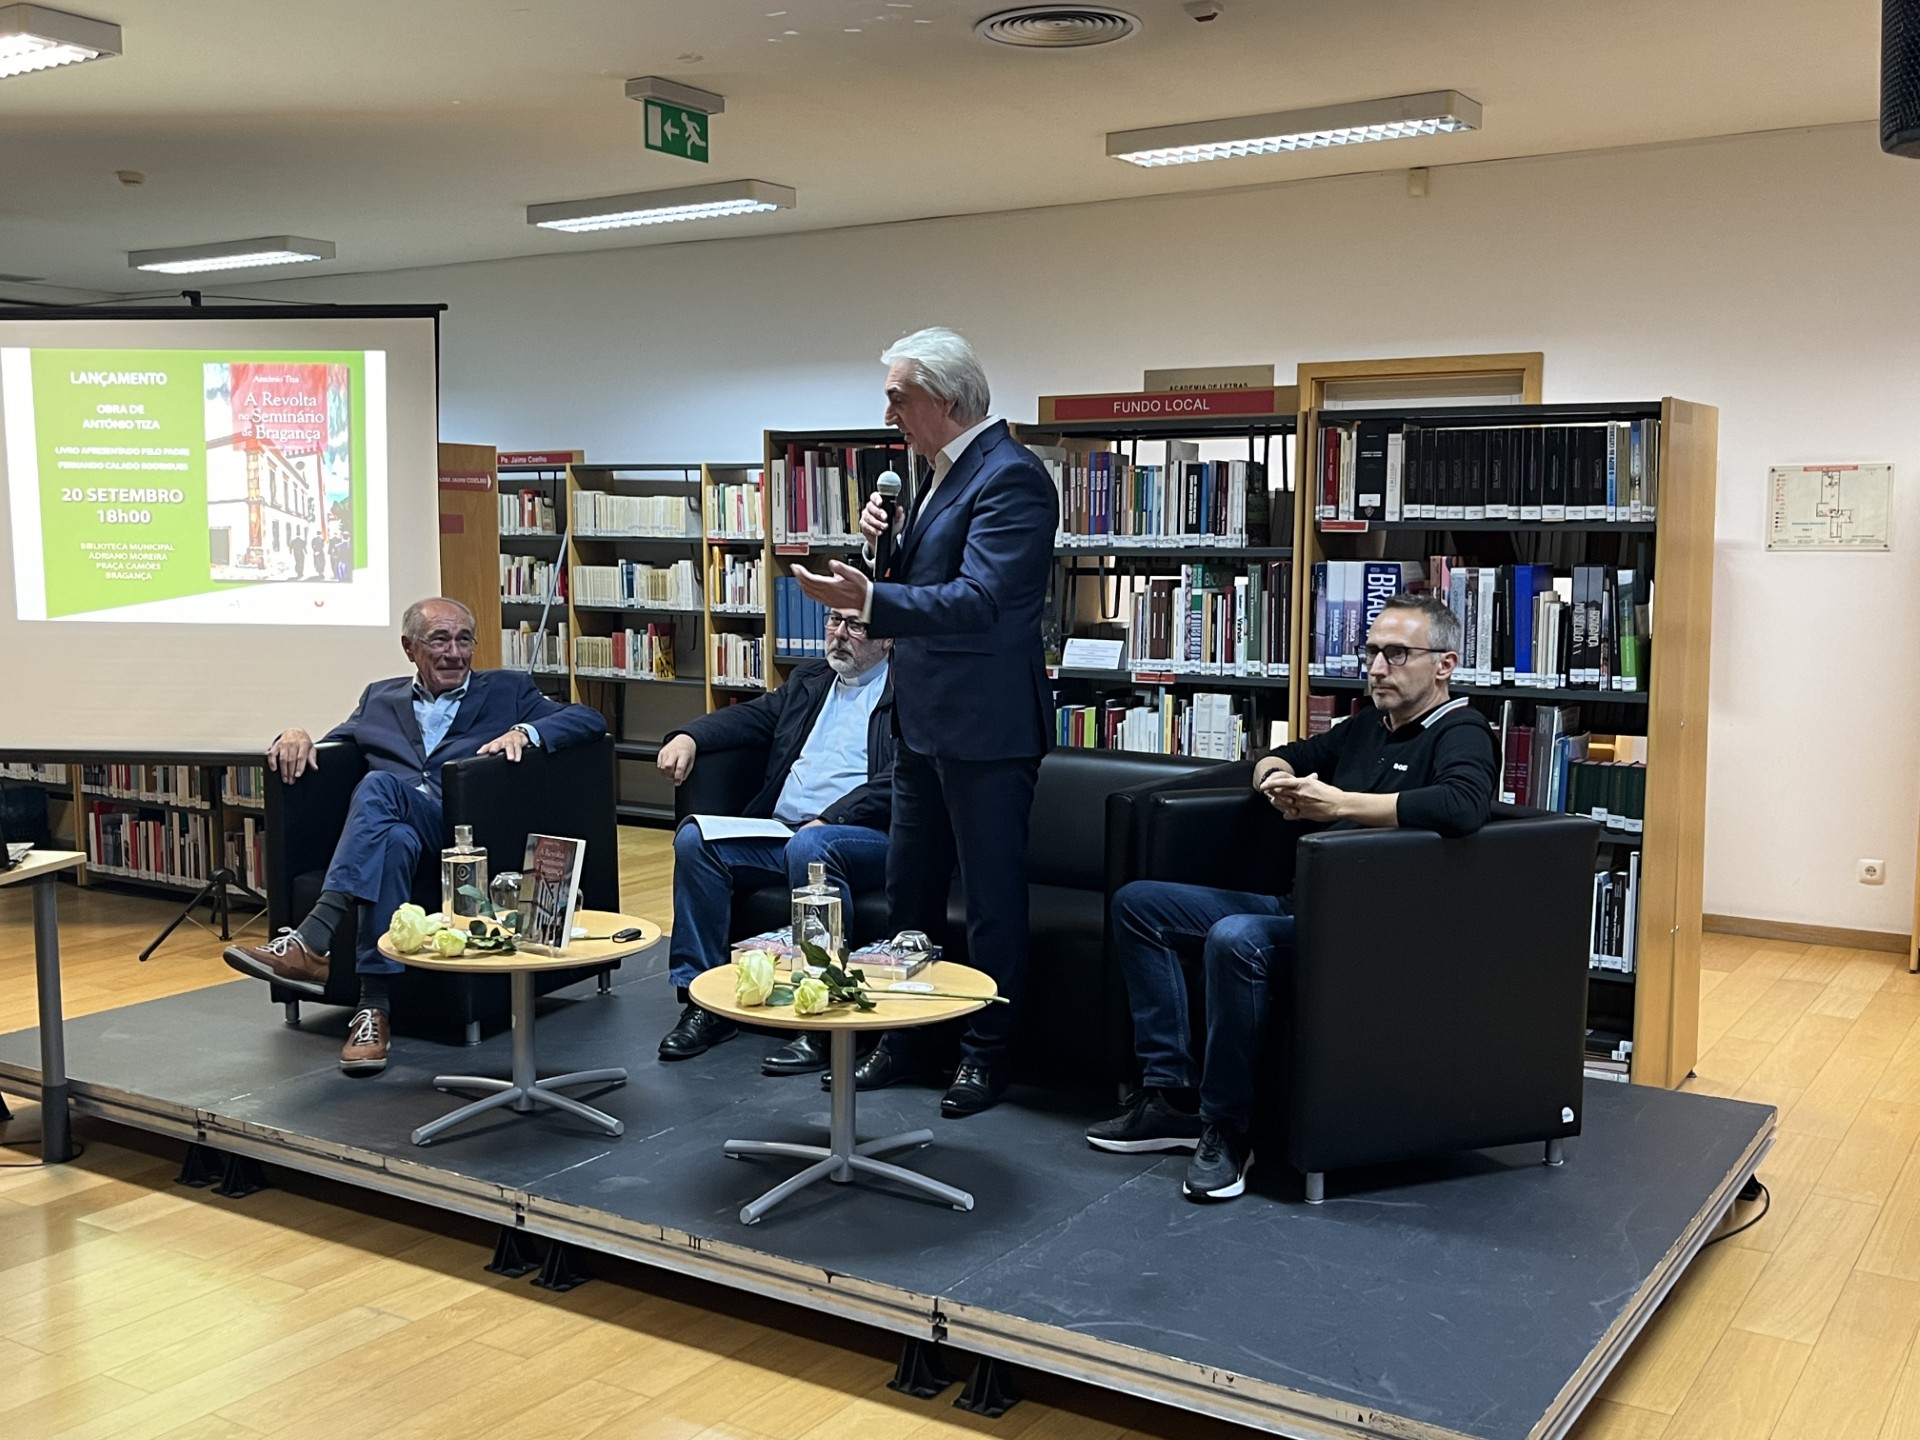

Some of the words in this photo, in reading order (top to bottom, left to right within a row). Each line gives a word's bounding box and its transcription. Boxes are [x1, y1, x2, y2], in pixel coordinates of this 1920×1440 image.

[70, 372, 168, 388] LANÇAMENTO
[244, 392, 258, 407] A
[262, 391, 317, 407] Revolta
[1113, 400, 1161, 414] FUNDO
[1165, 398, 1210, 412] LOCAL
[96, 404, 128, 415] OBRA
[129, 404, 145, 415] DE
[251, 407, 325, 424] Seminário
[82, 418, 134, 430] ANTÓNIO
[134, 419, 161, 430] TIZA
[255, 424, 321, 443] Bragança
[511, 456, 527, 464] Jaime
[527, 455, 548, 464] Coelho
[61, 487, 84, 502] 20
[87, 487, 184, 503] SETEMBRO
[96, 508, 151, 524] 18h00
[80, 542, 129, 551] BIBLIOTECA
[129, 543, 176, 551] MUNICIPAL
[88, 552, 128, 560] ADRIANO
[129, 552, 168, 561] MOREIRA
[96, 562, 124, 571] PRAÇA
[125, 562, 162, 570] CAMÕES
[105, 571, 152, 581] BRAGANÇA
